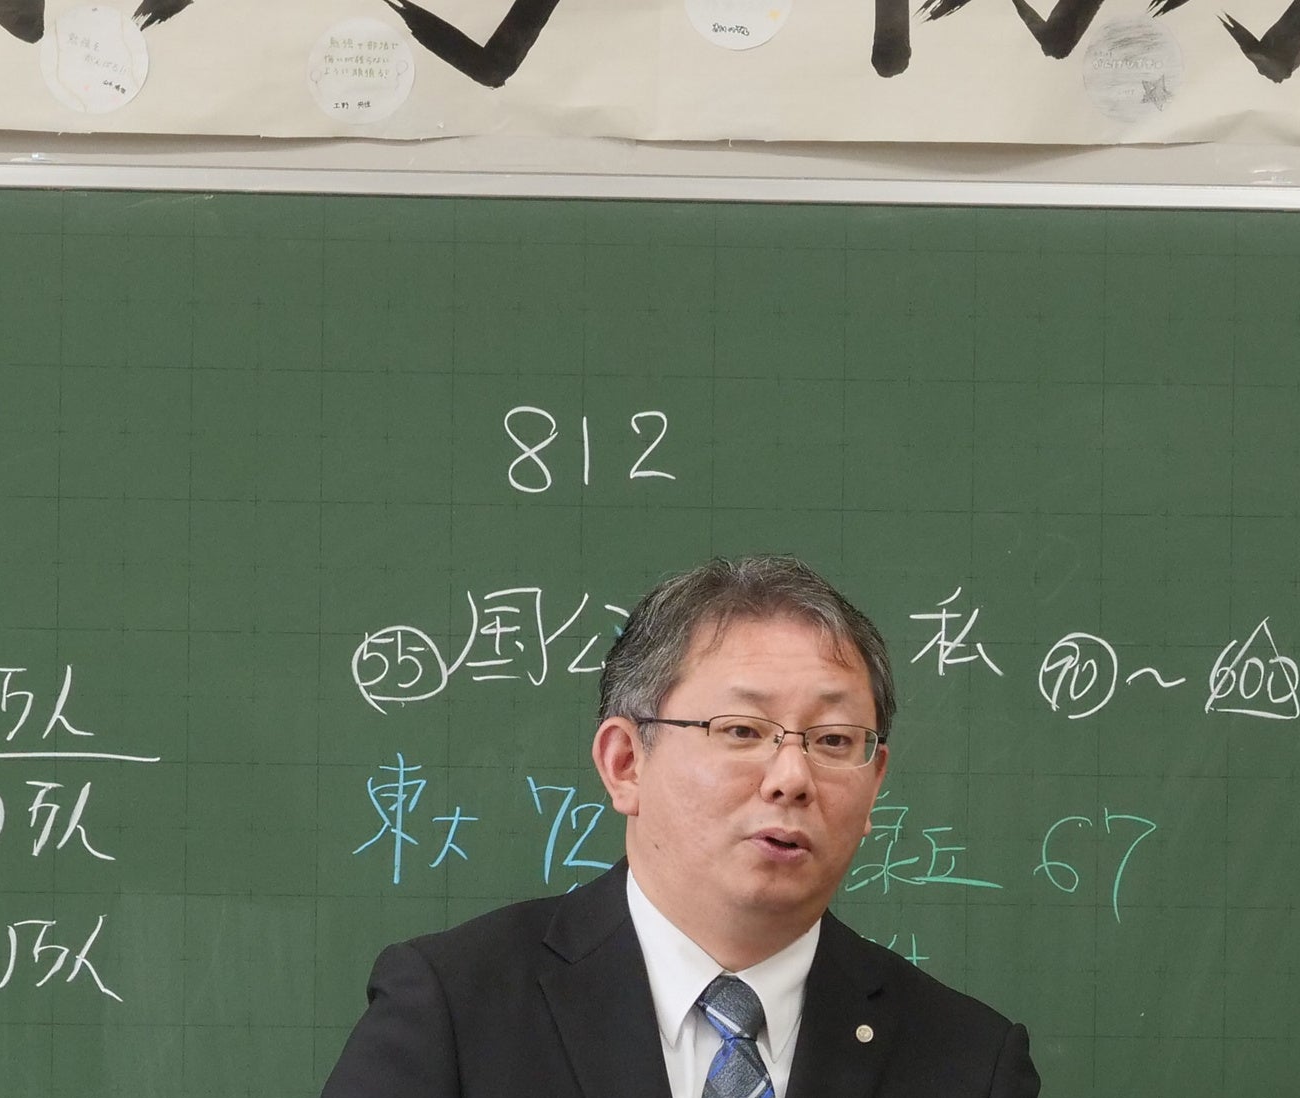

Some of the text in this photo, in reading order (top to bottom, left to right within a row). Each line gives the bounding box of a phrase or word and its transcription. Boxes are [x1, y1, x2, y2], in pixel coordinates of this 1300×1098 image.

[504, 405, 676, 493] 812
[911, 587, 1004, 676] 私
[352, 752, 479, 885] 東大
[526, 776, 615, 885] 72
[1033, 807, 1157, 923] 67
